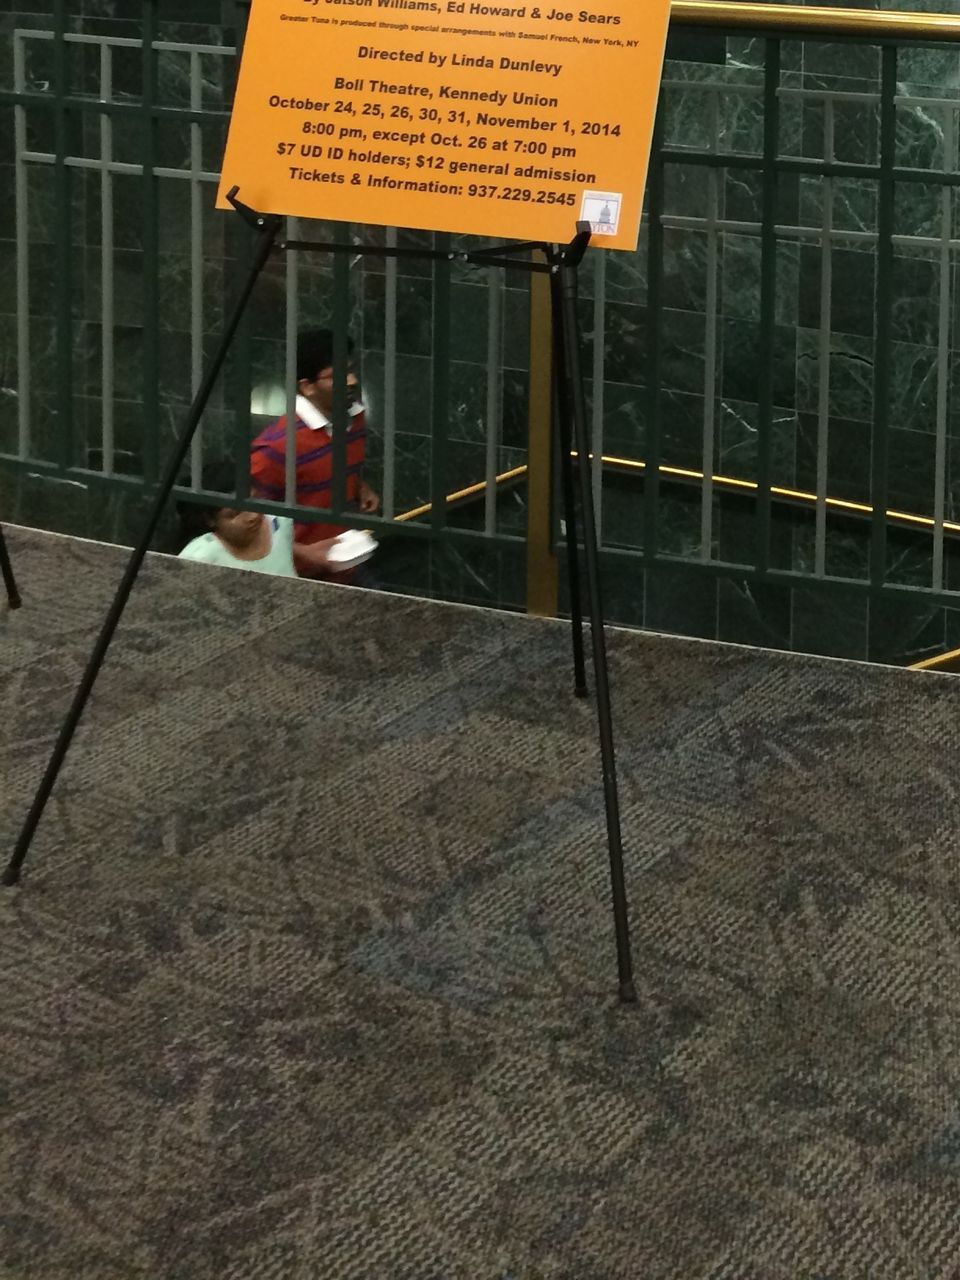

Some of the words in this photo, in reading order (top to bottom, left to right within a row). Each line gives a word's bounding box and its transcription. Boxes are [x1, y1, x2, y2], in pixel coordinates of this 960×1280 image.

[279, 13, 309, 23] Greater
[311, 16, 330, 24] Tuna
[340, 19, 377, 28] produced
[378, 21, 409, 31] through
[410, 24, 440, 33] special
[441, 27, 496, 37] arrangements
[518, 32, 549, 41] Samuel
[550, 34, 580, 44] French,
[603, 38, 624, 48] York,
[626, 40, 640, 48] NY
[446, 1, 465, 13] Ed
[469, 3, 526, 18] Howard
[531, 7, 541, 19] &
[546, 9, 574, 22] Joe
[578, 10, 621, 25] Sears
[357, 46, 425, 63] Directed
[428, 51, 447, 68] by
[451, 53, 494, 69] Linda
[499, 57, 562, 77] Dunlevy
[334, 77, 364, 91] Boll
[369, 80, 434, 99] Theatre,
[438, 85, 507, 106] Kennedy
[512, 91, 558, 108] Union
[268, 95, 330, 112] October
[334, 100, 356, 116] 24,
[361, 102, 385, 119] 25,
[390, 105, 413, 121] 26,
[418, 108, 442, 124] 30,
[447, 110, 471, 127] 31,
[476, 112, 557, 132] November
[562, 120, 576, 136] 1,
[581, 122, 621, 137] 2014
[302, 121, 335, 136] 8:00
[338, 127, 368, 142] pm,
[372, 129, 426, 146] except
[430, 132, 462, 147] Oct.
[467, 135, 488, 150] 26
[492, 139, 509, 152] at
[513, 140, 547, 155] 7:00
[551, 145, 577, 159] pm
[276, 141, 296, 156] $7
[300, 144, 323, 158] UD
[327, 147, 344, 160] ID
[348, 149, 411, 169] holders;
[415, 154, 445, 170] $12
[449, 160, 509, 176] general
[513, 165, 597, 184] admission
[289, 167, 345, 184] Tickets
[350, 173, 361, 186] &
[367, 175, 464, 196] Information:
[468, 184, 576, 206] 937.229.2545
